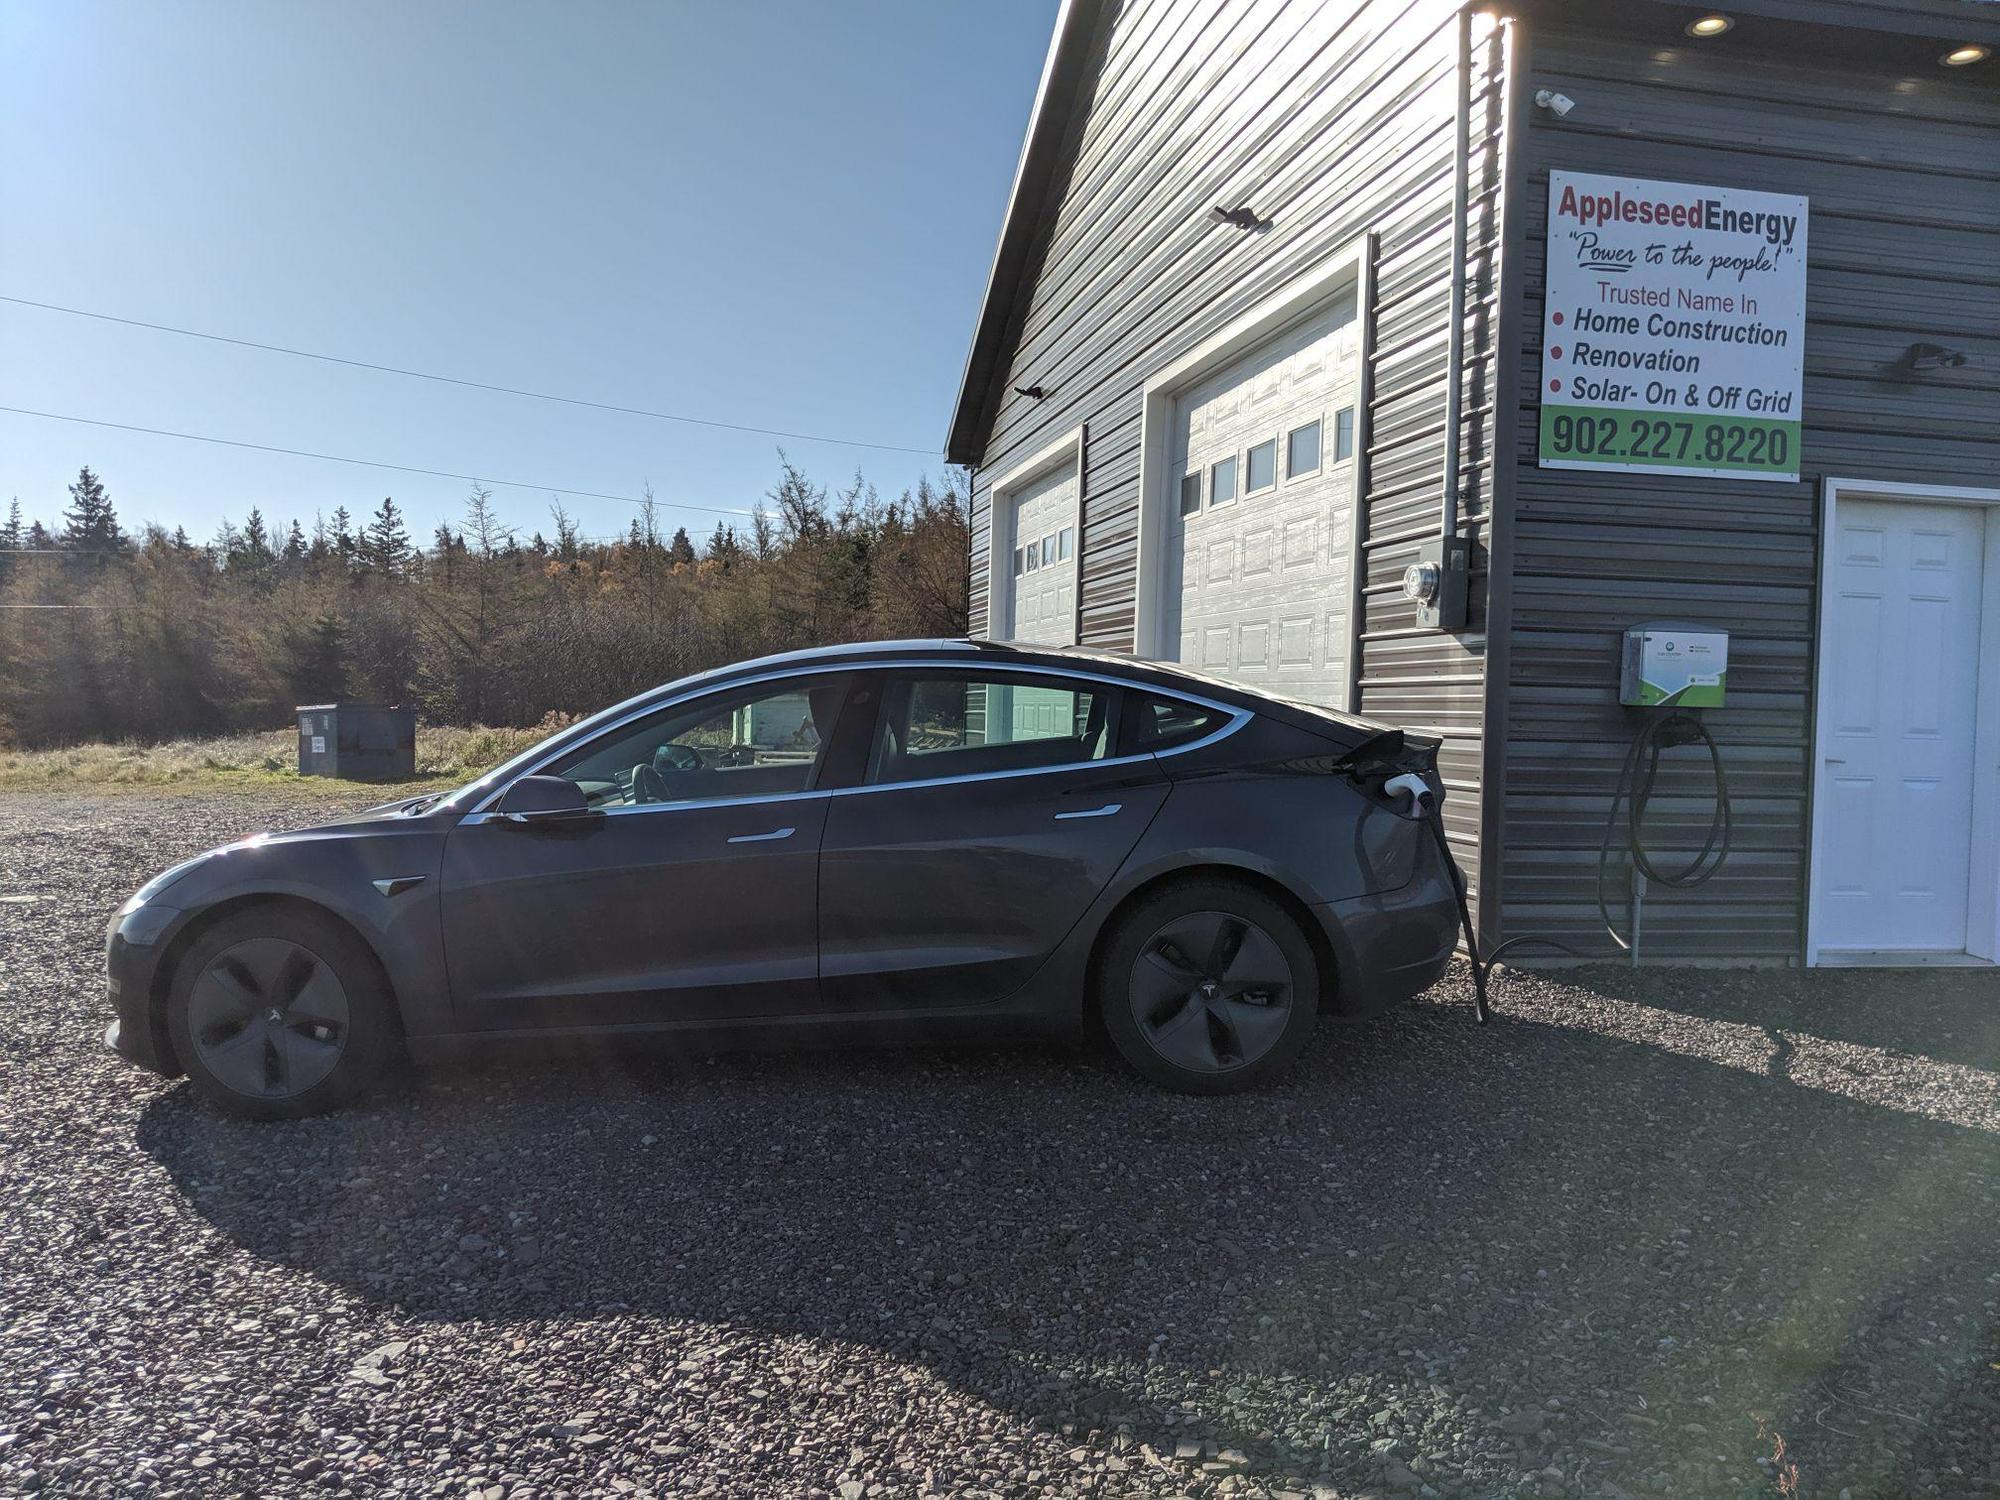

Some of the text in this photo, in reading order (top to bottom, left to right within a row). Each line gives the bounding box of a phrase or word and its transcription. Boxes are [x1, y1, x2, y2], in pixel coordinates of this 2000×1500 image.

[1645, 243, 1665, 265] to
[1671, 241, 1703, 267] the
[1597, 281, 1757, 315] Trusted Name In
[1573, 308, 1788, 347] Home Construction
[1572, 342, 1700, 373] Renovation
[1571, 376, 1793, 414] Solar- On & Off Grid
[1553, 415, 1788, 466] 902.227.8220
